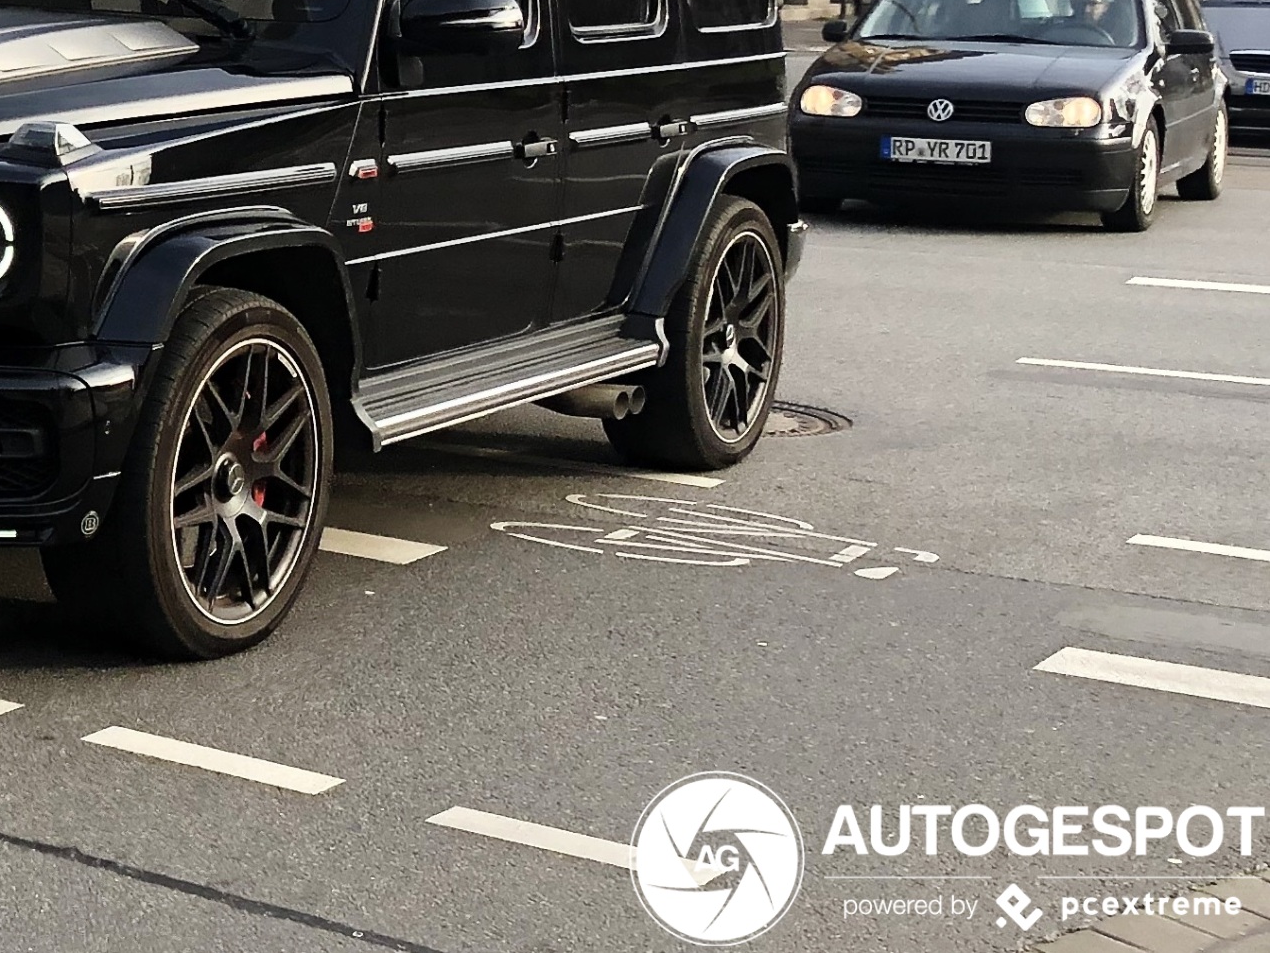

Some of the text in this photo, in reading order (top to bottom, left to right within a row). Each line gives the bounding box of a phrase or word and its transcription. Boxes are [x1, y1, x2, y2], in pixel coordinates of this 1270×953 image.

[892, 139, 989, 161] RP YR 701
